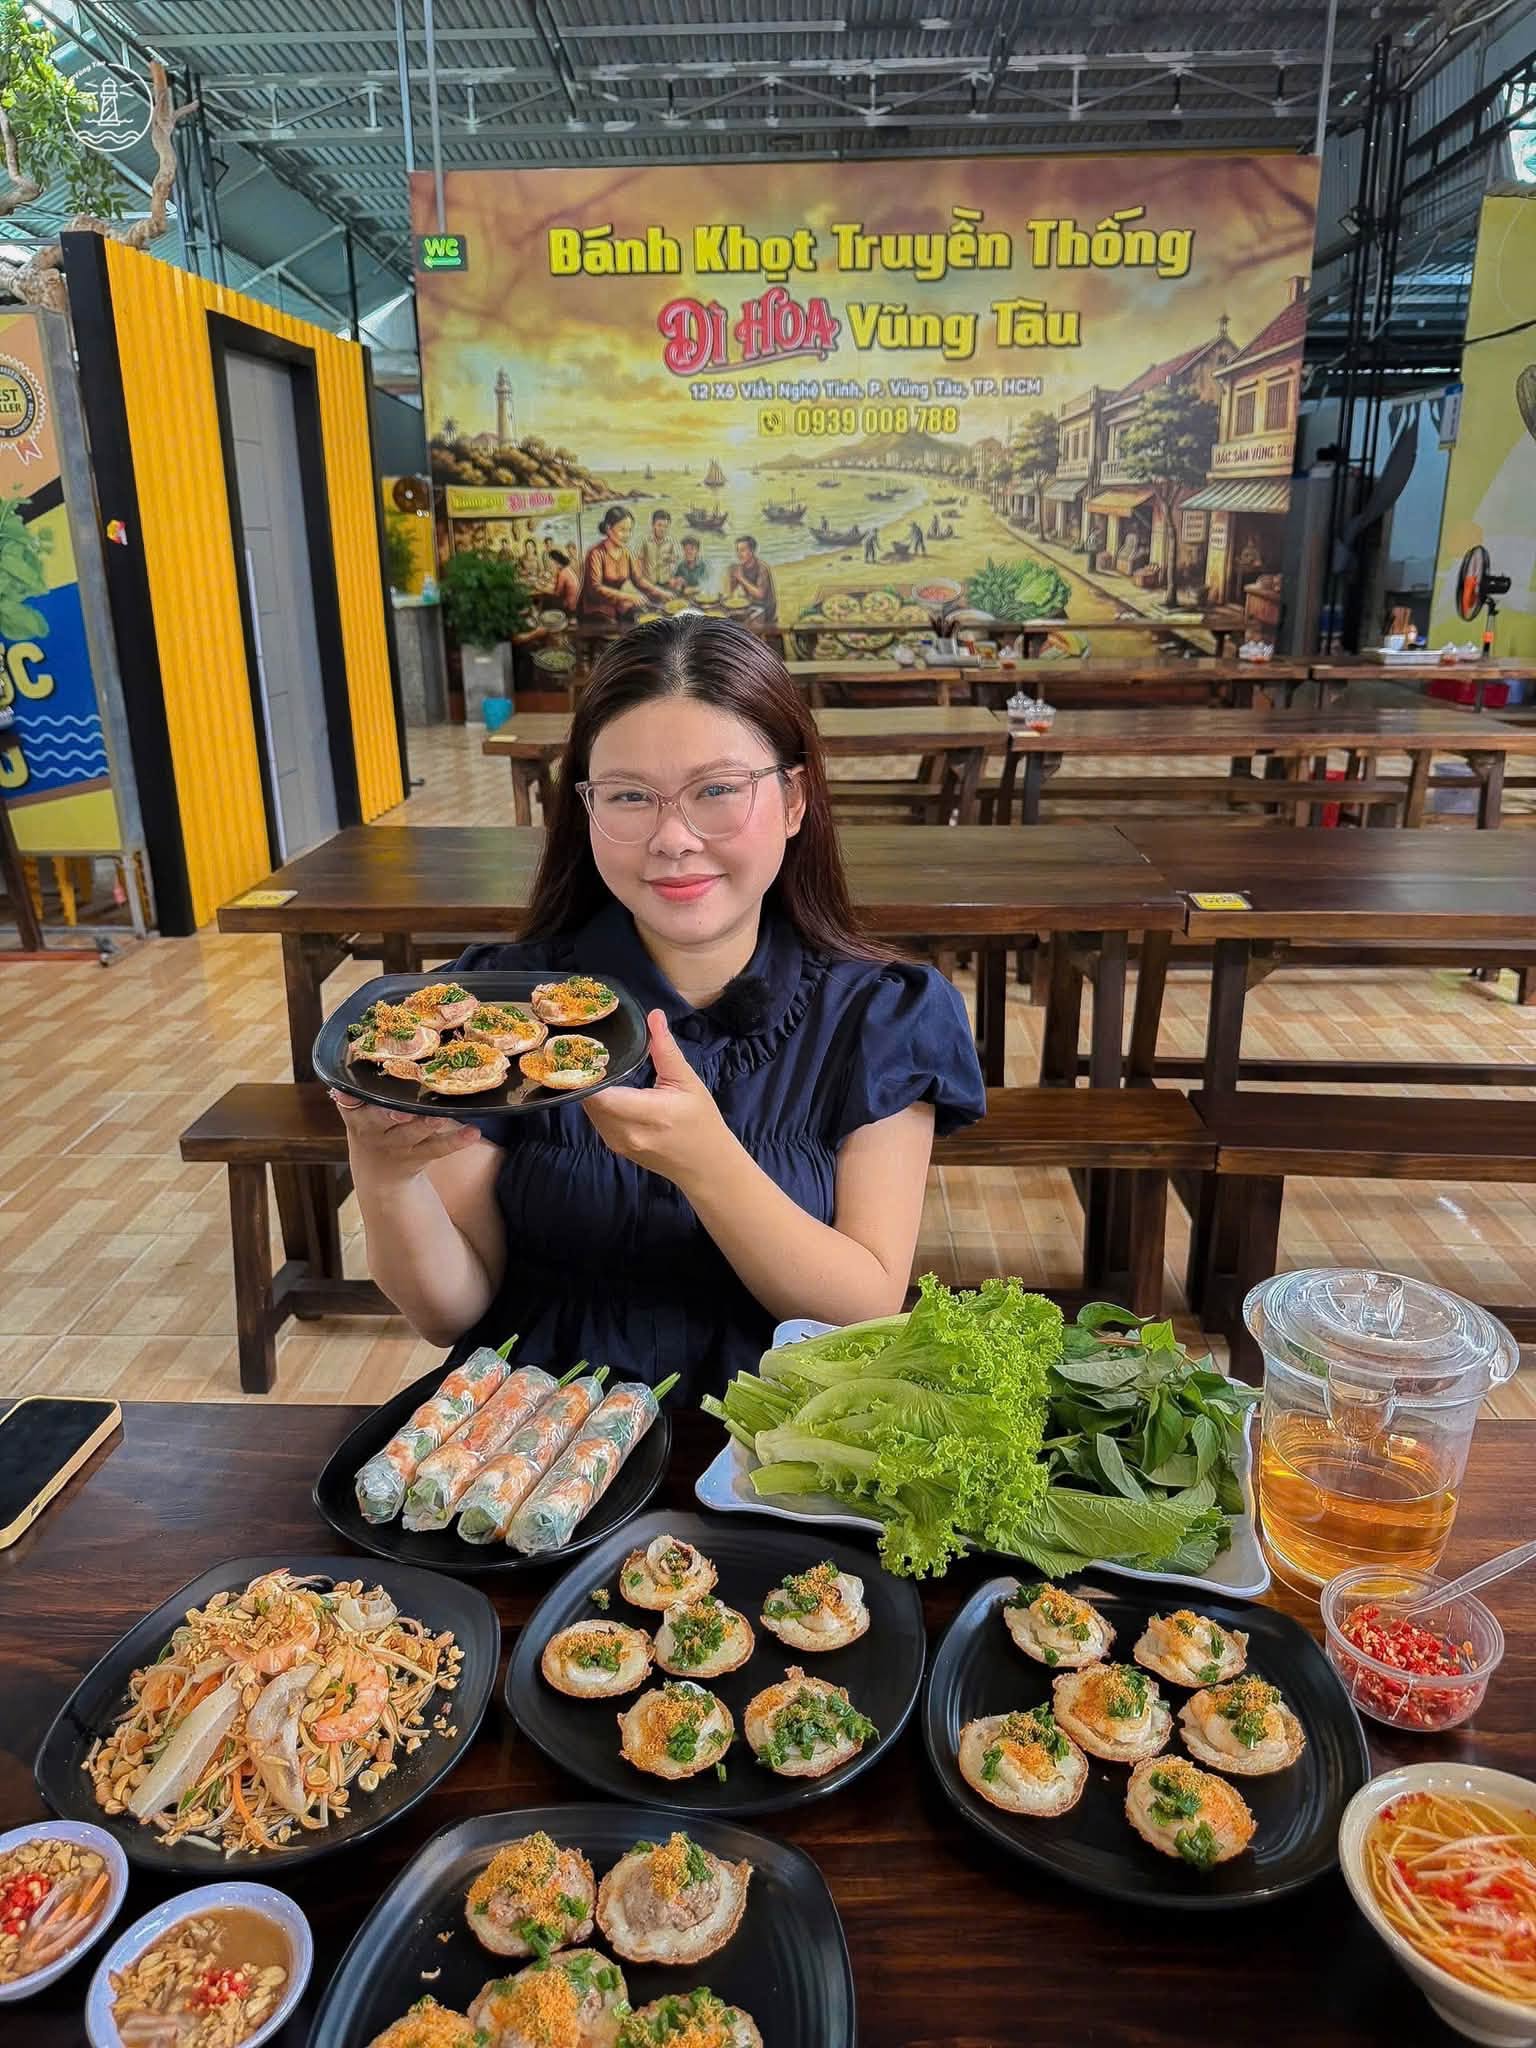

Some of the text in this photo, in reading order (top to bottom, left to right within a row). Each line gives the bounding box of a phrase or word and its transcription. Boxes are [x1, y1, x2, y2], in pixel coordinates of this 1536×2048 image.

[424, 238, 459, 257] WC
[549, 205, 1195, 282] Bánh Khọt Truyền Thống
[734, 286, 841, 360] HOA
[846, 302, 978, 360] Vũng
[991, 297, 1081, 348] Tàu
[0, 388, 18, 402] ST
[868, 379, 885, 397] P.
[972, 377, 998, 397] TP.
[1002, 377, 1042, 396] HCM
[795, 406, 959, 435] 0939 008 788
